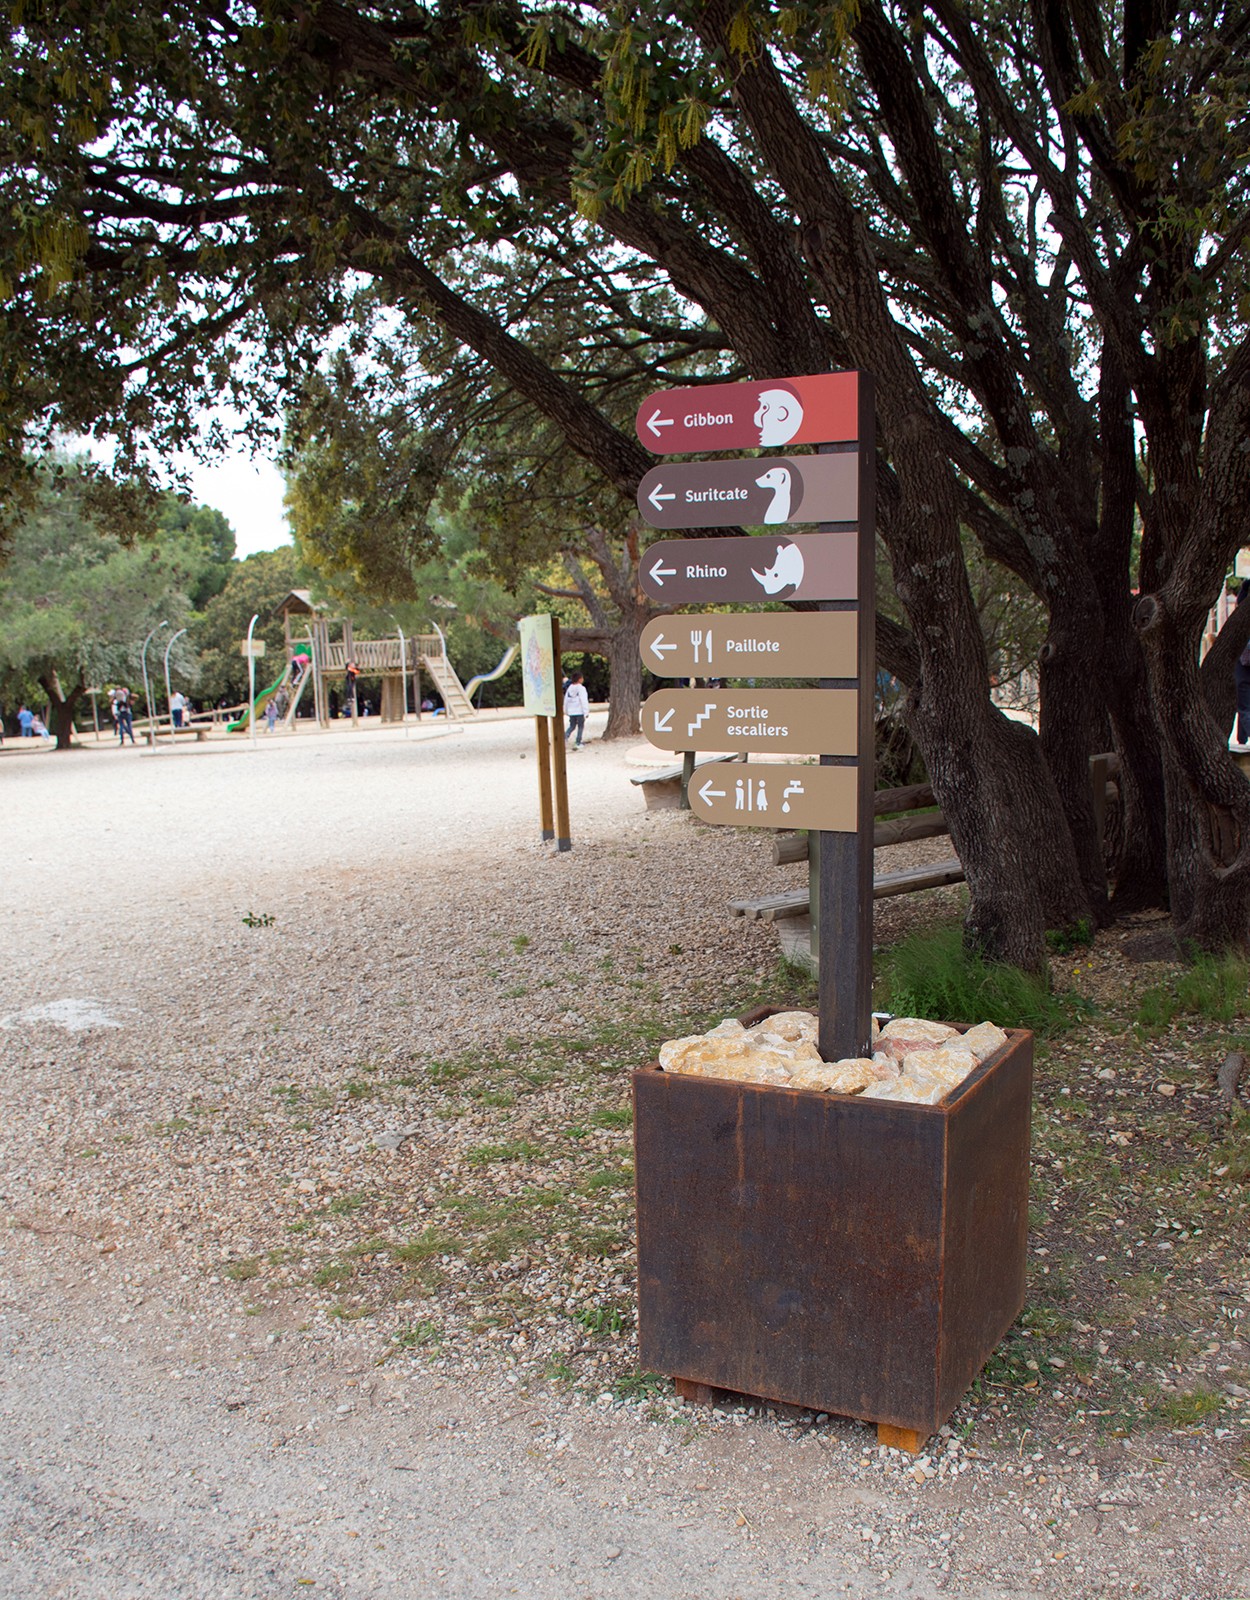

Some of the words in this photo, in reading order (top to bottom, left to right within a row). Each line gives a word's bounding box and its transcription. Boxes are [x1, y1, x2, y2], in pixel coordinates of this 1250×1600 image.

[683, 412, 734, 428] Gibbon
[685, 486, 748, 503] Suritcate
[686, 563, 728, 578] Rhino
[726, 638, 780, 652] Paillote
[727, 705, 769, 719] Sortie
[727, 722, 789, 737] escaliers
